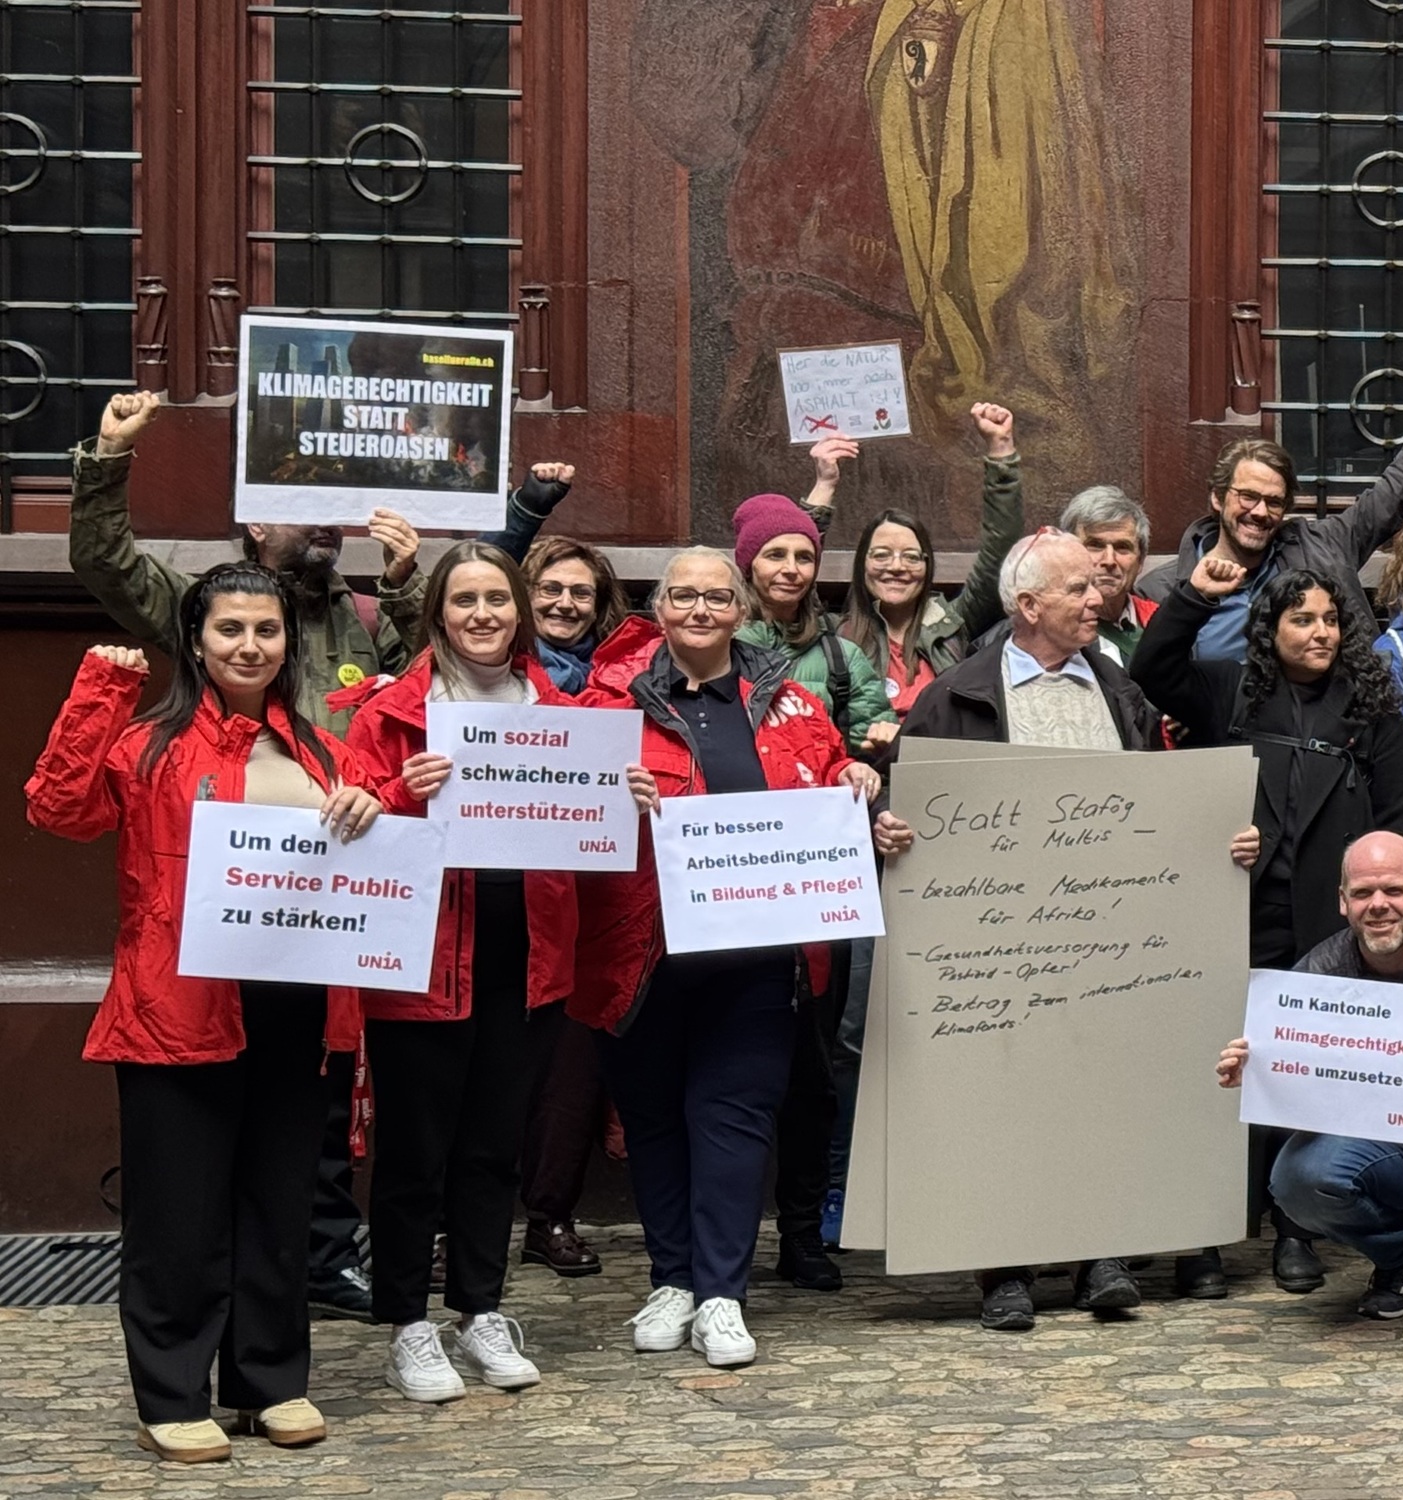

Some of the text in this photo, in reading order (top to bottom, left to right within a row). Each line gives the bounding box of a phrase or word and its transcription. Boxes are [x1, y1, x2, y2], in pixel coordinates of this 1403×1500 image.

[787, 347, 891, 373] Her die NATUR
[258, 372, 493, 407] KLIMAGERECHTIGKEIT
[794, 391, 859, 415] ASPHALT
[343, 405, 408, 430] STATT
[299, 432, 449, 461] STEUEROASEN
[463, 726, 569, 748] Um sozial
[461, 763, 620, 786] schwächere zu
[460, 801, 605, 822] unterstützen!
[917, 793, 1022, 841] Statt
[682, 820, 784, 837] Für bessere
[991, 827, 1112, 853] für Multis
[229, 830, 327, 856] Um den
[686, 845, 859, 870] Arbeitsbedingungen
[225, 867, 414, 900] Service Public
[690, 876, 863, 903] in Bildung & Pflege!
[922, 867, 1180, 899] bezahlbare Medikamente
[221, 907, 367, 933] zu stärken!
[978, 908, 1015, 925] für
[925, 935, 1169, 963] Gesundheitsversorgung für
[931, 995, 1011, 1018] Beitrag
[1278, 994, 1392, 1019] Um Kantonale
[1271, 1060, 1310, 1075] ziele
